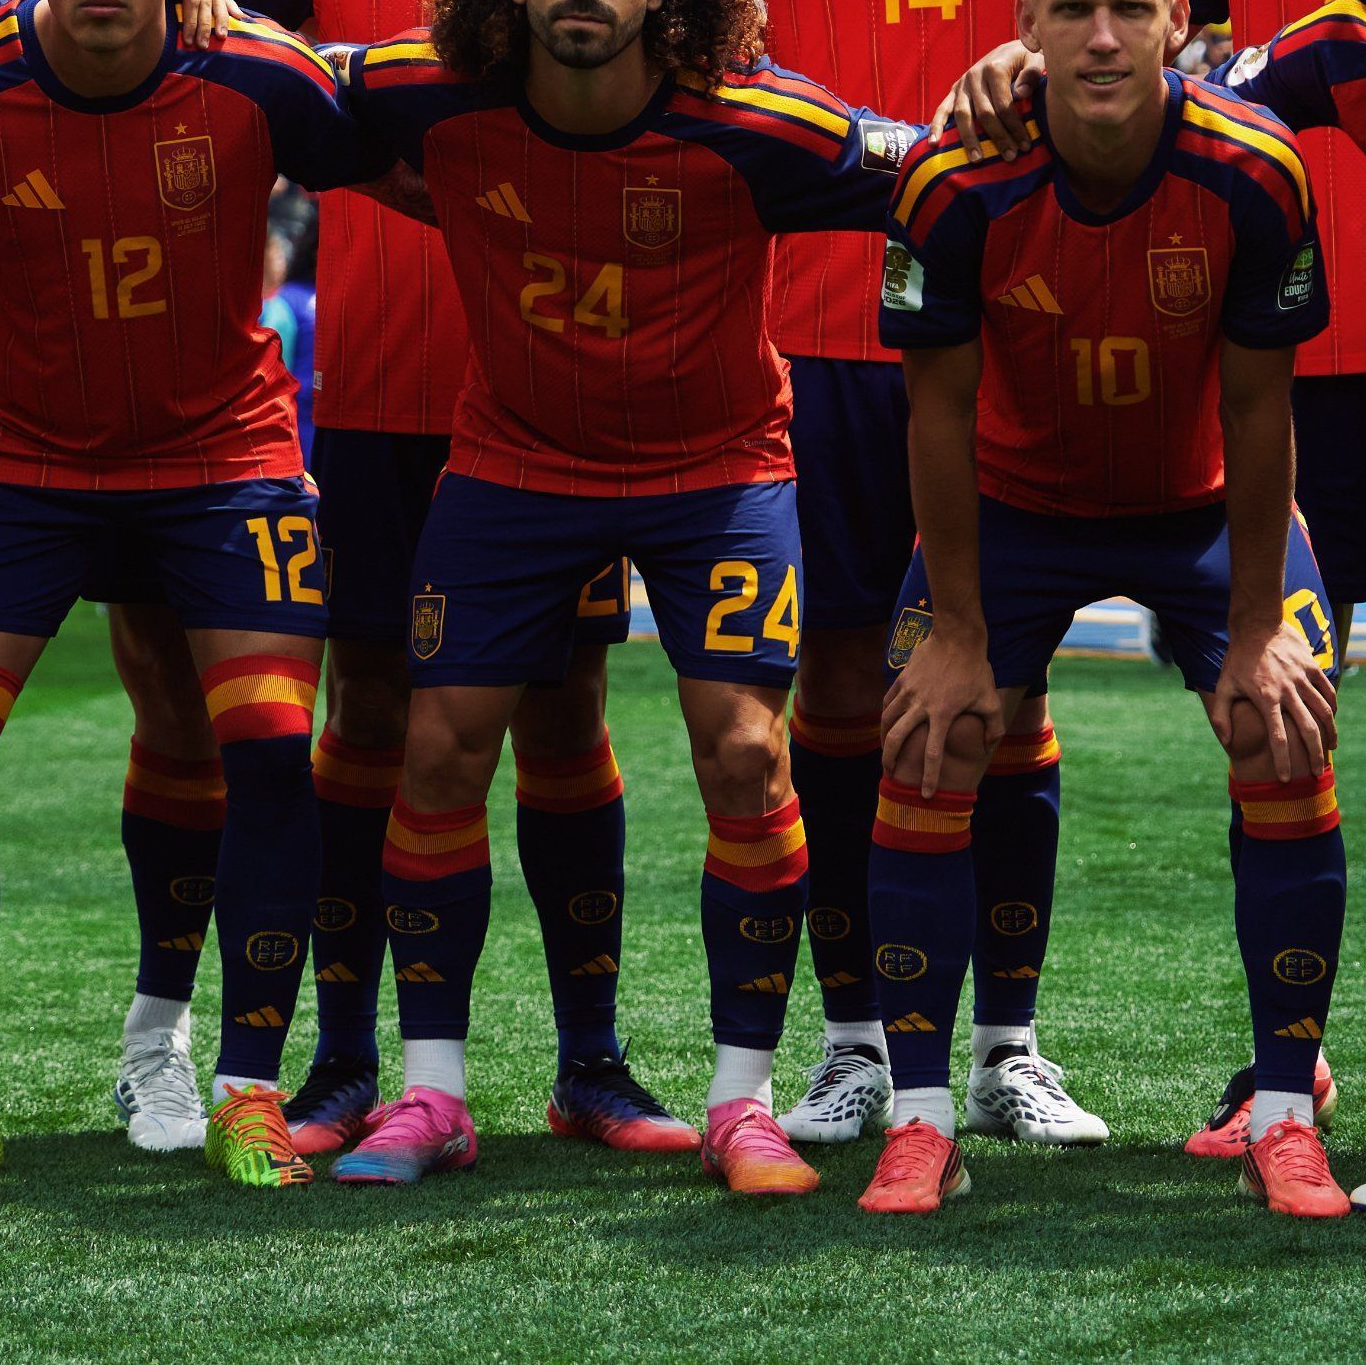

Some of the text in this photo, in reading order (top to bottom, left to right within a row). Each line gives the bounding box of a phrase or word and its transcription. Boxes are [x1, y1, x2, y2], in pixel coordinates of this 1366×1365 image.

[82, 236, 167, 319] 12
[520, 251, 630, 338] 24
[1070, 336, 1150, 406] 10
[245, 516, 323, 605] 12
[704, 560, 801, 659] 24
